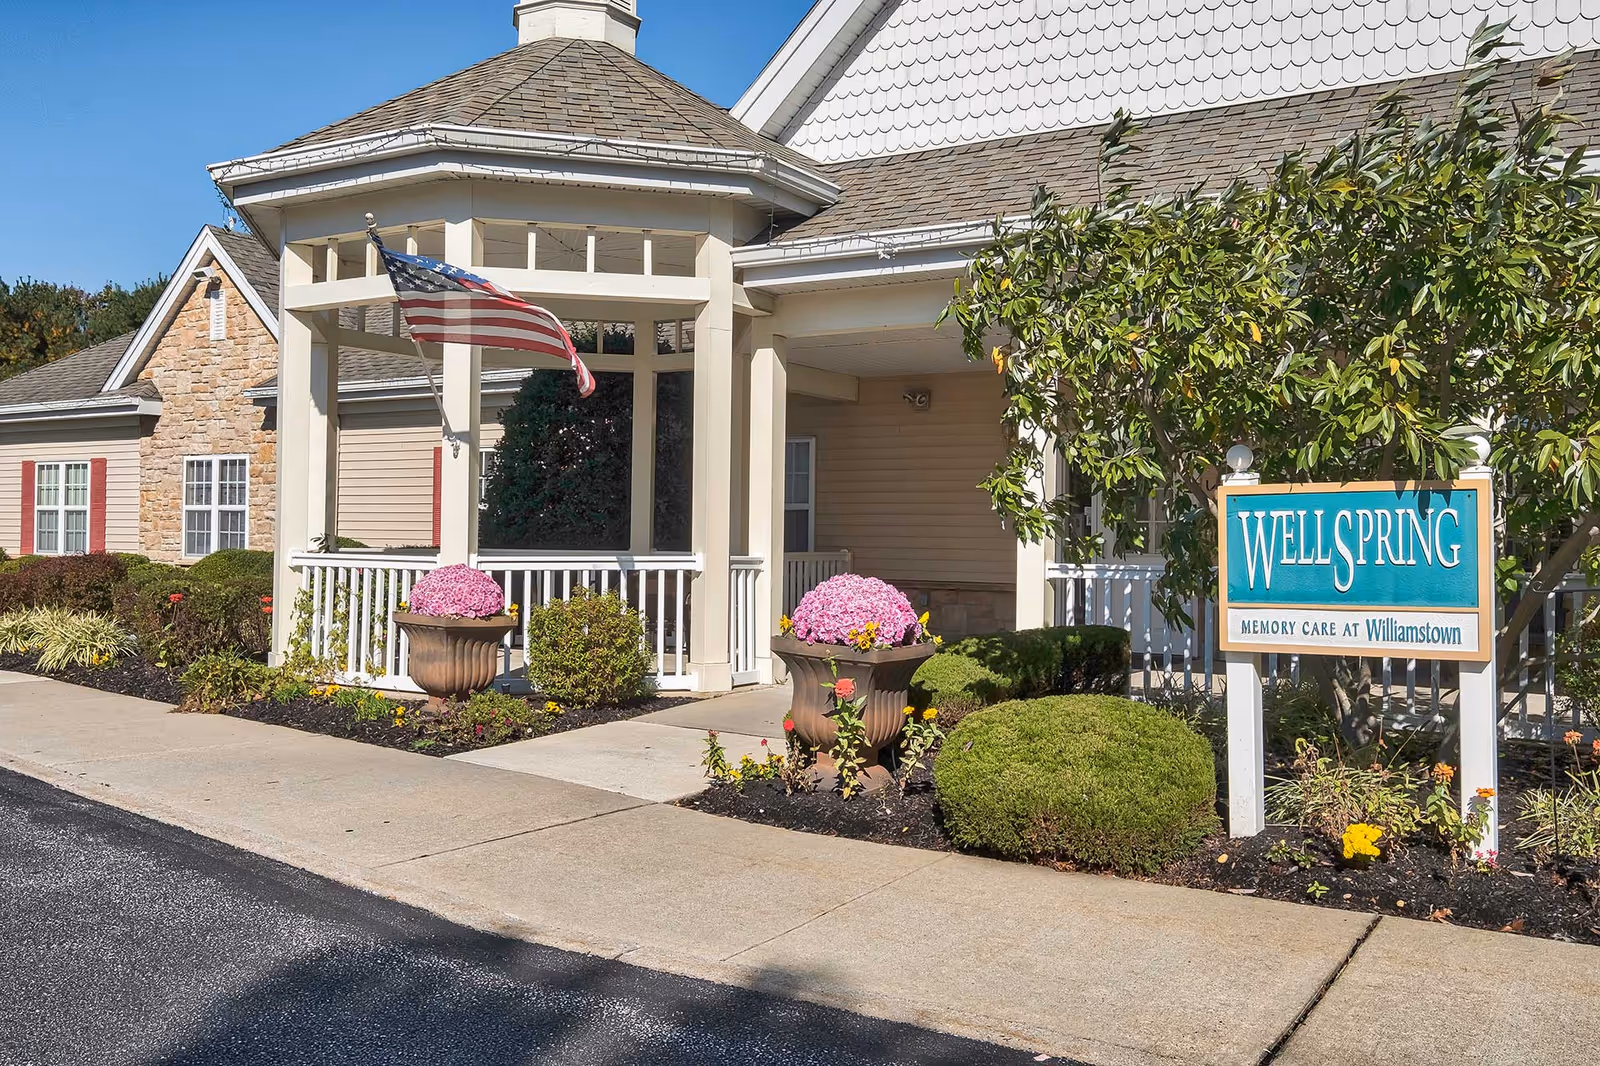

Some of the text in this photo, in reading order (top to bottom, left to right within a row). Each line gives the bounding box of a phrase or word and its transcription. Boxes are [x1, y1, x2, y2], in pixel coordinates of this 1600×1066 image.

[1241, 617, 1462, 645] MEMORY CARE AT Williamstown
